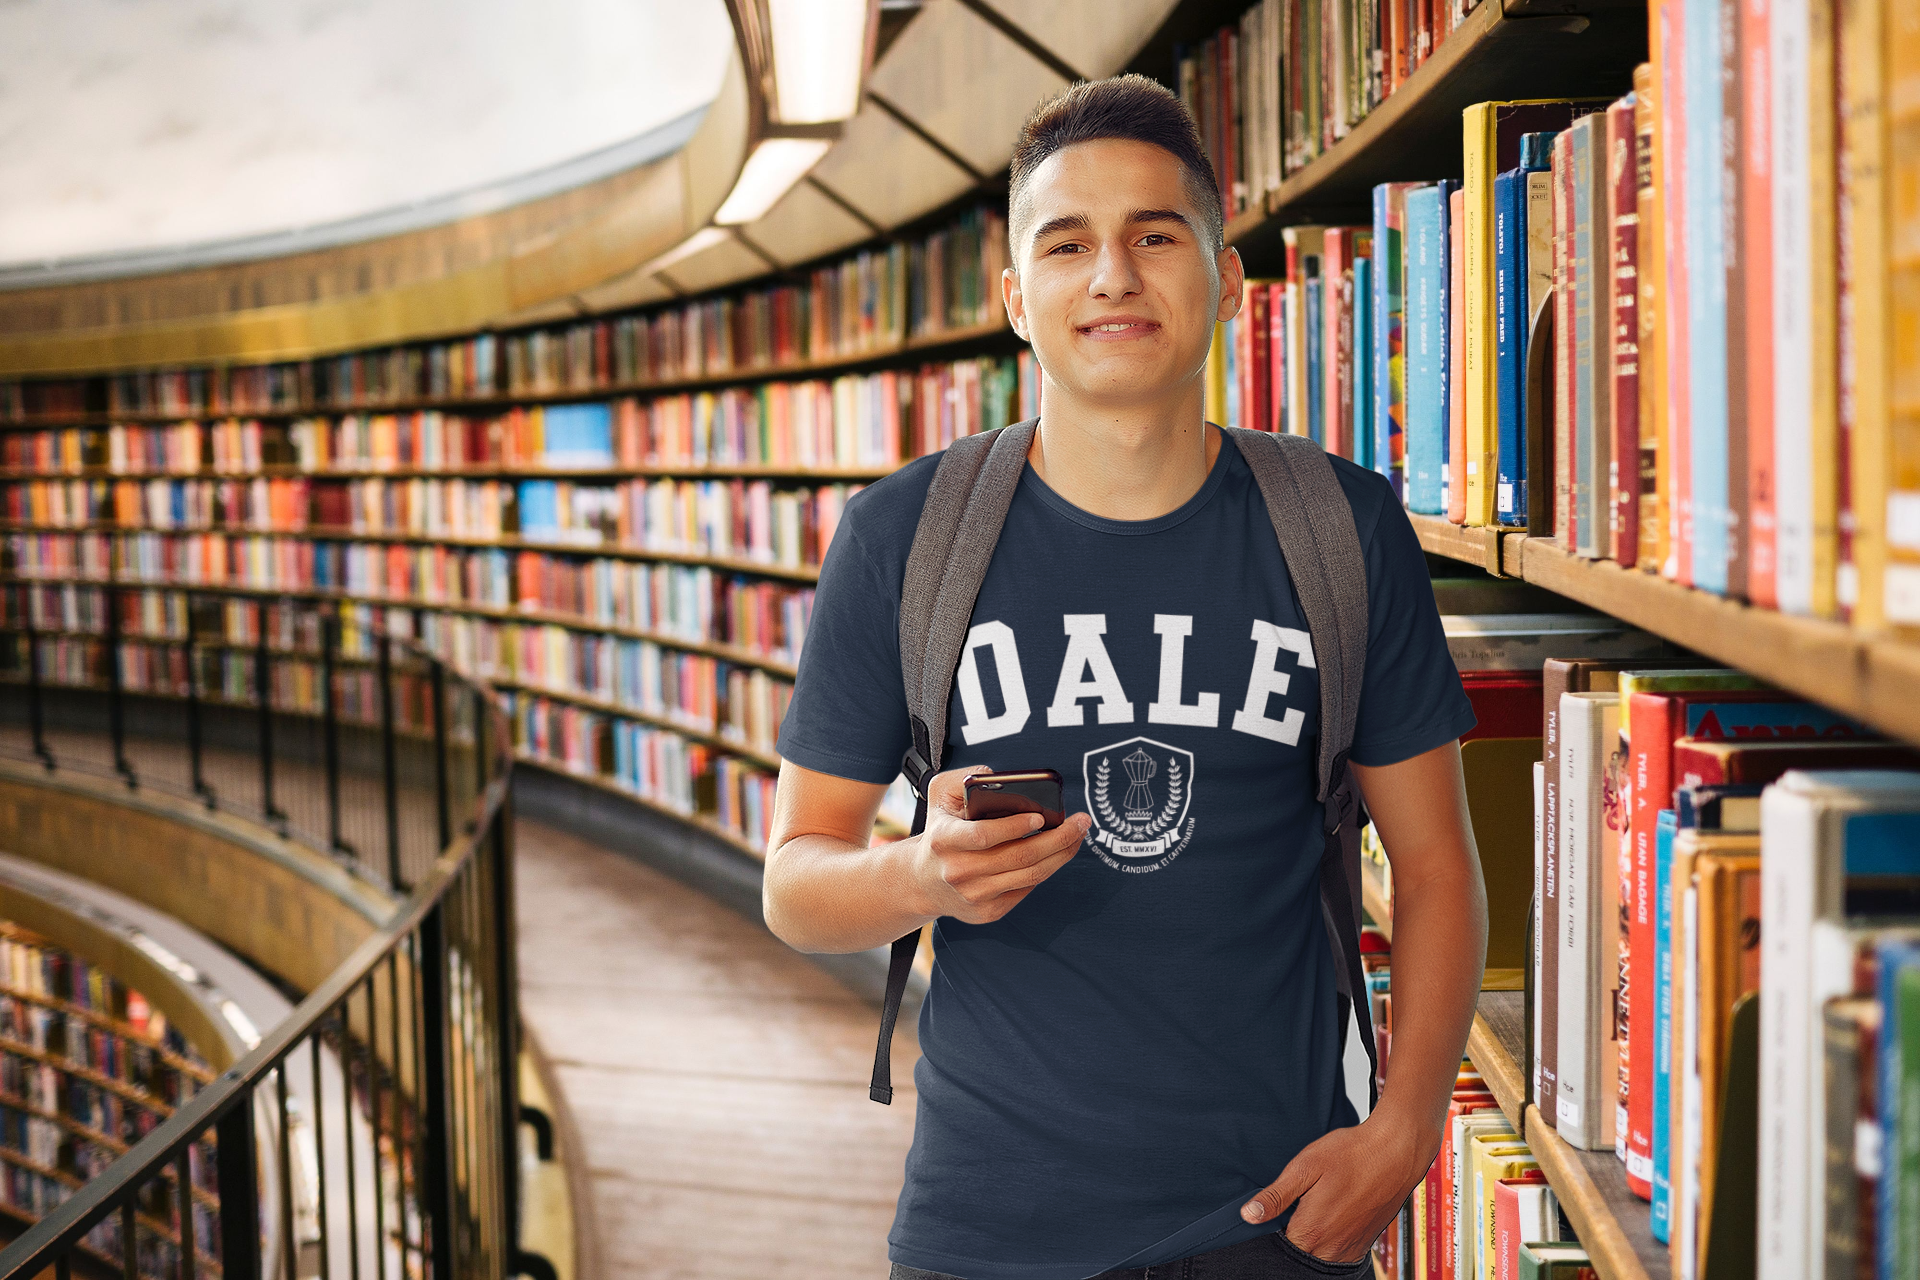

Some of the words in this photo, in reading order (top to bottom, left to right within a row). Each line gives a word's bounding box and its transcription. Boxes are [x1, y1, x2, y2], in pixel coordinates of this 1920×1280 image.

[957, 613, 1317, 747] DALE
[1548, 711, 1556, 745] TYLER,
[1637, 752, 1647, 792] TYLER,
[1160, 859, 1170, 867] ET
[1168, 817, 1196, 861] CAFFEINATUM
[1547, 783, 1556, 899] LAPPTÄCKSPLANETEN
[1637, 832, 1647, 866] UTAN
[1637, 870, 1647, 924] BAGAGE
[1618, 944, 1630, 1016] ANNE
[1618, 1019, 1630, 1096] TYLER
[1501, 1230, 1509, 1280] TOWNSEND
